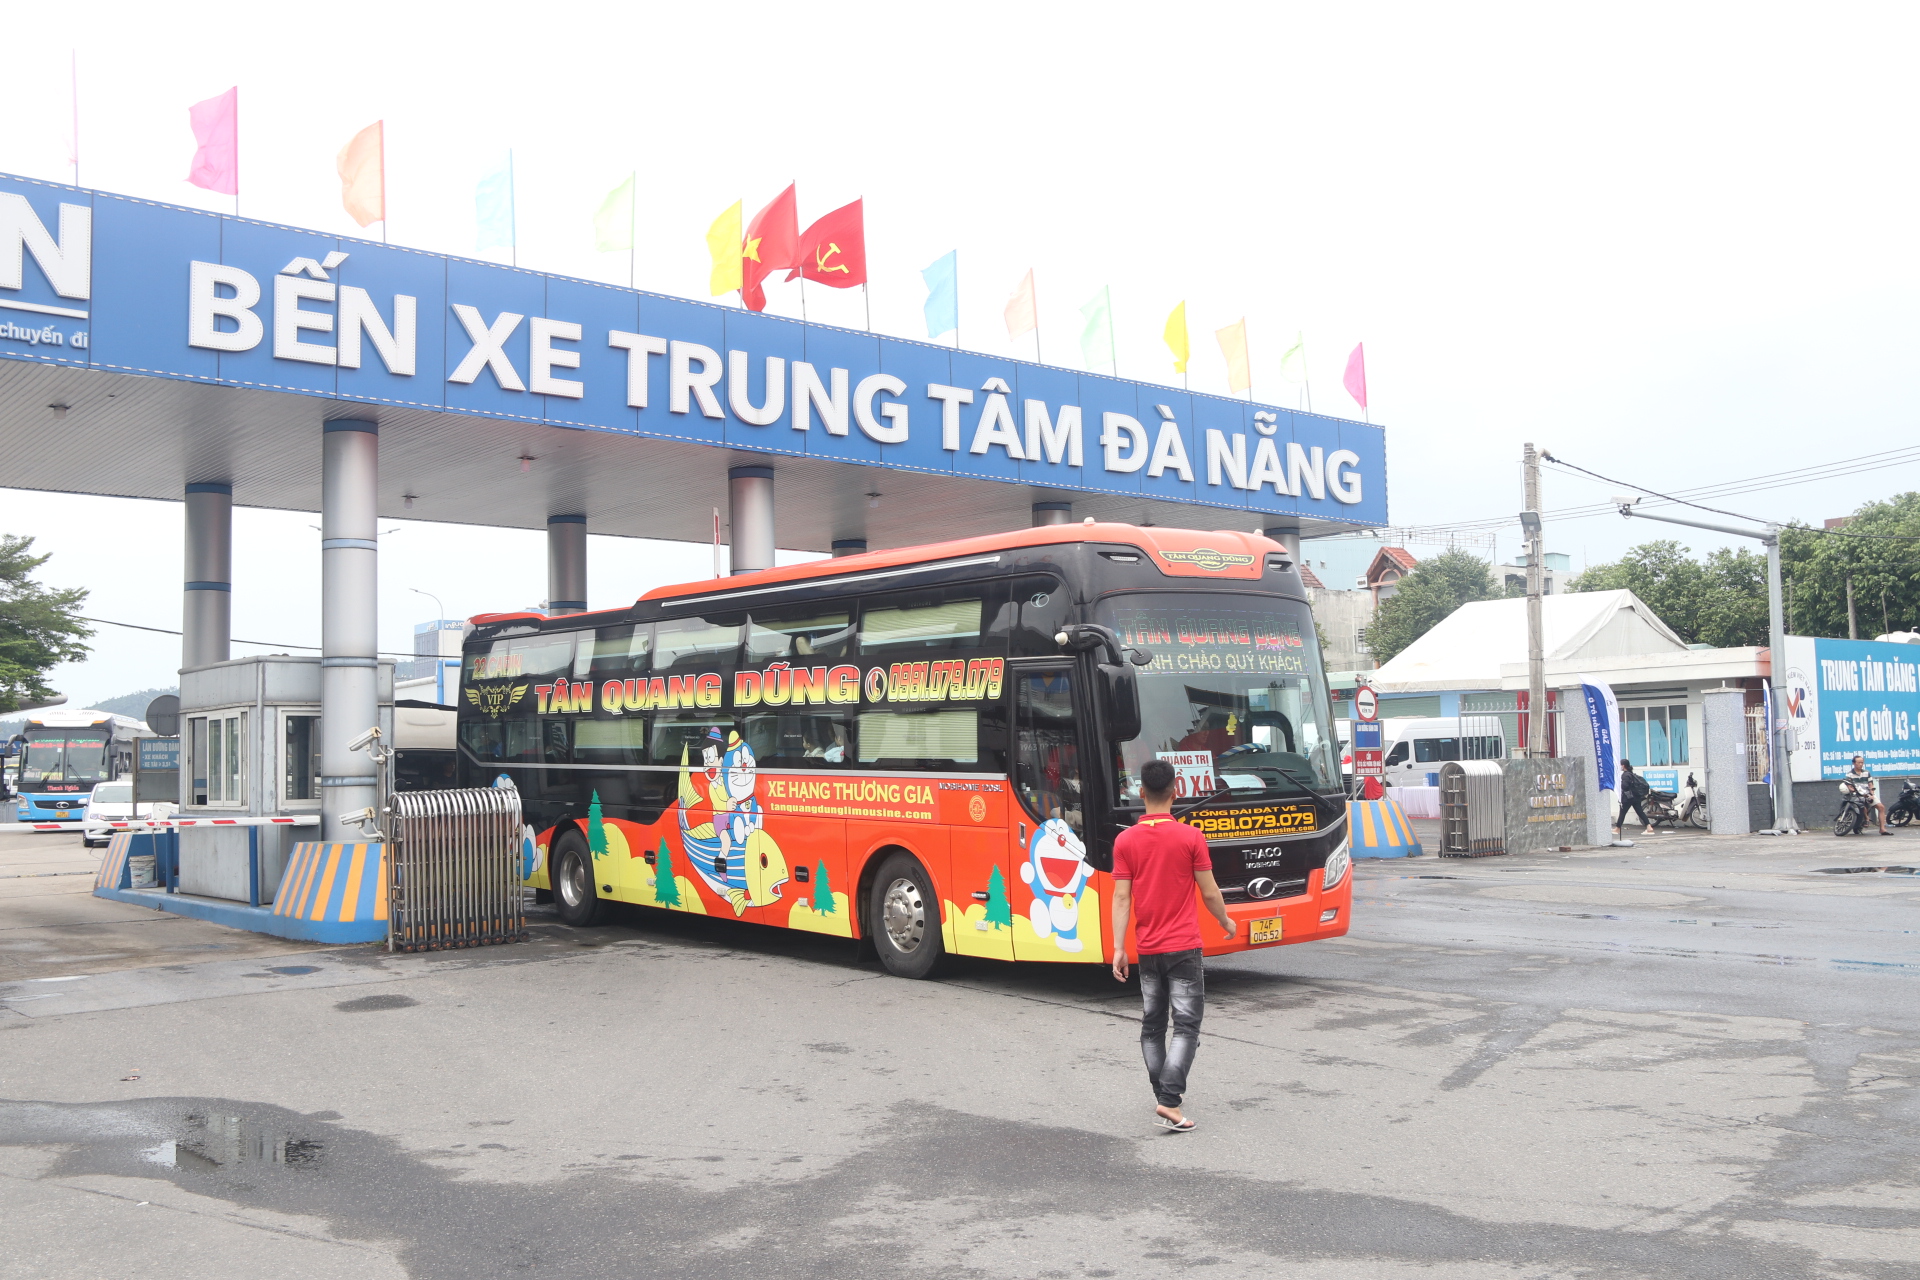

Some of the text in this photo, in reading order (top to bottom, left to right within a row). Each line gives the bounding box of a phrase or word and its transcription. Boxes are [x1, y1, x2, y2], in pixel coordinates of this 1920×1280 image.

[0, 322, 88, 348] chuyến đi
[188, 250, 1363, 505] BẾN XE TRUNG TÂM ĐÀ NẴNG
[1119, 611, 1304, 649] TÂN QUANG DŨNG
[472, 653, 523, 680] 22 CABIN
[1177, 649, 1221, 671] CHÀO
[1225, 650, 1254, 671] QUÝ
[1258, 652, 1303, 672] KHÁCH
[1821, 659, 1859, 691] TRUNG
[1860, 654, 1885, 692] TÂM
[1886, 656, 1917, 693] ĐĂNG
[534, 657, 1005, 716] TÂN QUANG DŨNG 0981.079.079
[487, 693, 504, 705] VIP
[1835, 710, 1851, 742] XE
[1852, 707, 1869, 742] CƠ
[1870, 704, 1893, 741] GIỚI
[1895, 711, 1909, 741] 43
[1601, 728, 1610, 744] GAZ
[1804, 741, 1816, 750] 2015
[1195, 755, 1209, 766] TRỊ
[767, 780, 934, 804] XE HẠNG THƯƠNG GIA
[1190, 770, 1216, 797] XÁ
[770, 802, 932, 820] tanquangdunglimousine.com
[1190, 804, 1298, 817] TỔNG ĐÀI ĐẶT VÉ
[1189, 812, 1315, 832] 0981.079.079
[1241, 846, 1282, 861] THACO
[1245, 860, 1280, 869] MOBIHOME
[1260, 919, 1274, 931] 74F
[1253, 929, 1279, 943] 005.52
